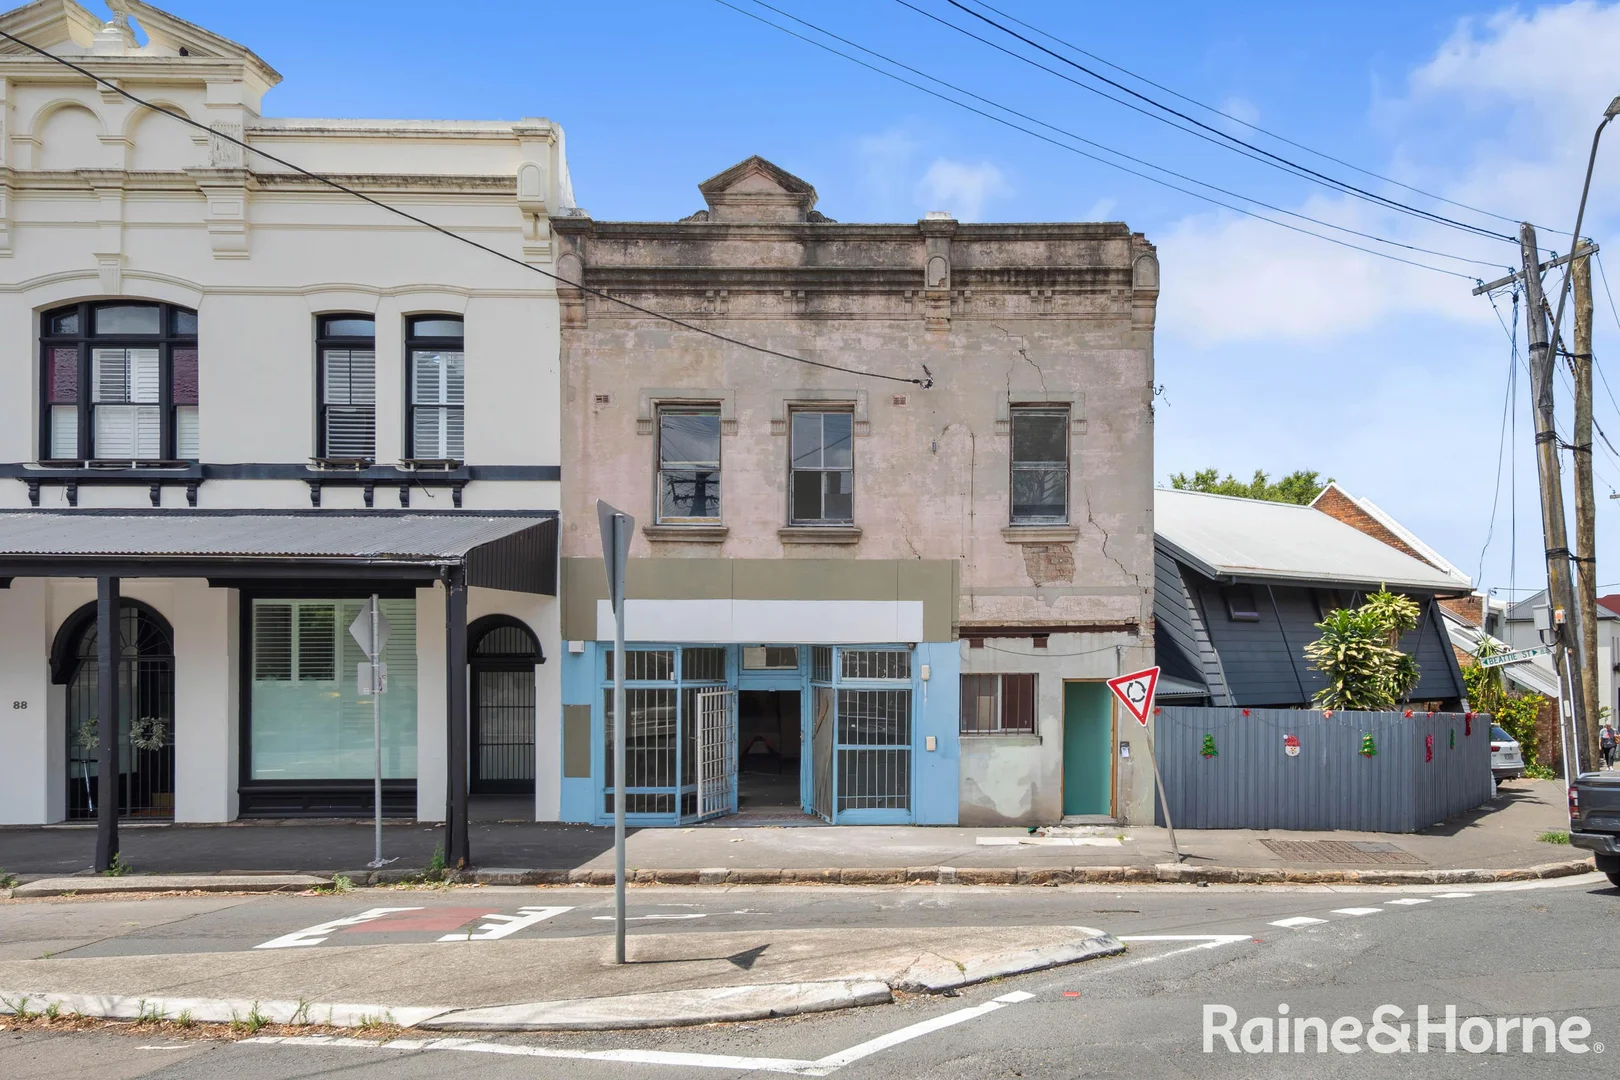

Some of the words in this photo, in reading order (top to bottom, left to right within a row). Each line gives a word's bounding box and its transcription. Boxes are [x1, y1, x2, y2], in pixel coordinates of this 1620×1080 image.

[1488, 653, 1517, 665] BEATTIE
[1522, 650, 1531, 658] ST
[13, 701, 28, 710] 88
